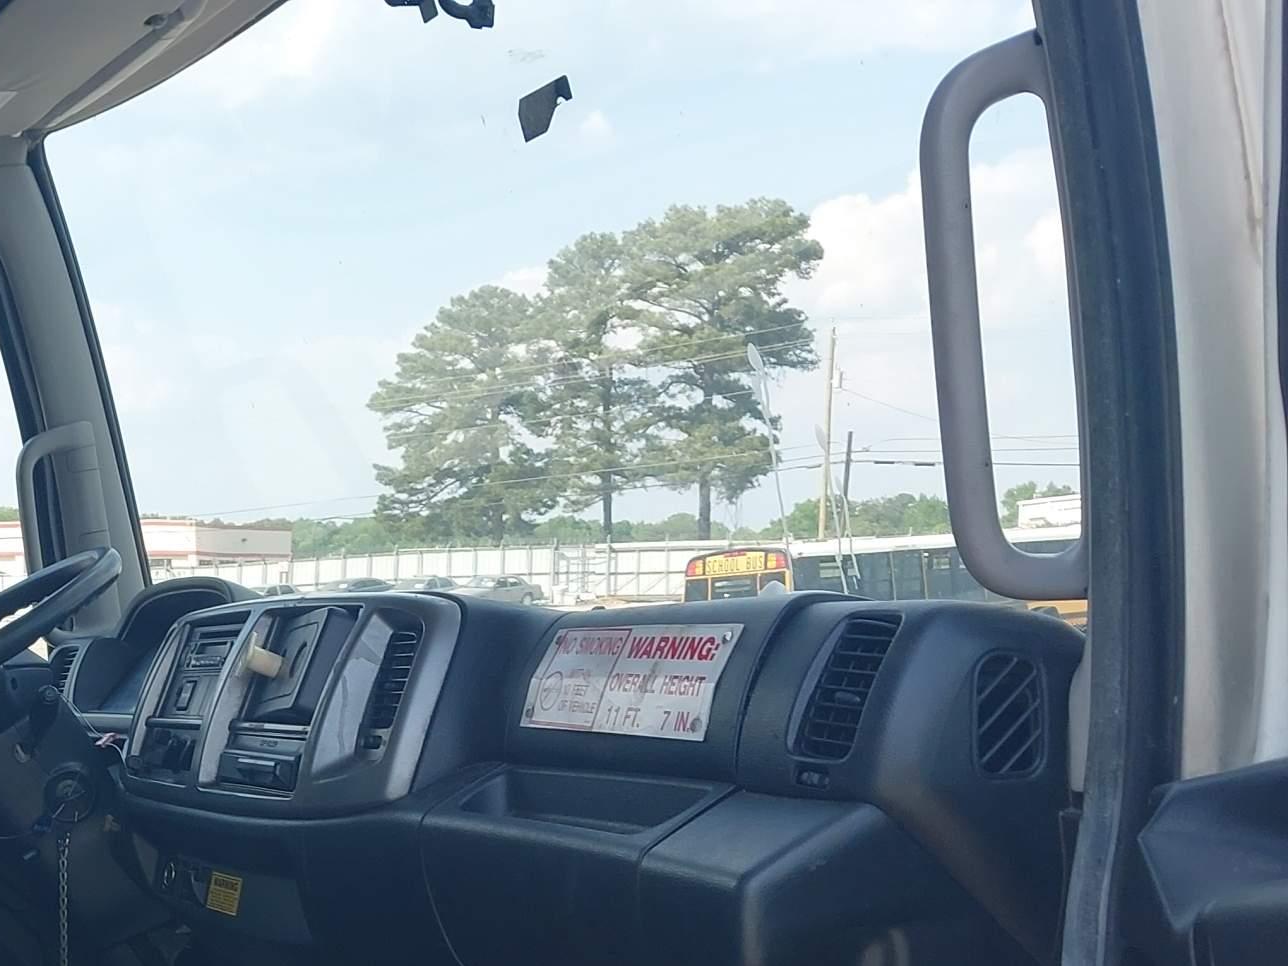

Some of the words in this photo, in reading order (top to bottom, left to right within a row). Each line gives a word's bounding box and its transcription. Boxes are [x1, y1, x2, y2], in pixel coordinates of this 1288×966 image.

[706, 559, 740, 574] SCHOOL
[746, 555, 763, 570] BUS
[558, 637, 576, 655] NO
[578, 636, 623, 656] SMOKING
[626, 636, 720, 662] WARNING:
[609, 673, 657, 694] OVERALL
[659, 675, 707, 697] HEIGHT
[606, 705, 621, 727] 11
[622, 706, 641, 729] FT.
[660, 710, 671, 731] 7
